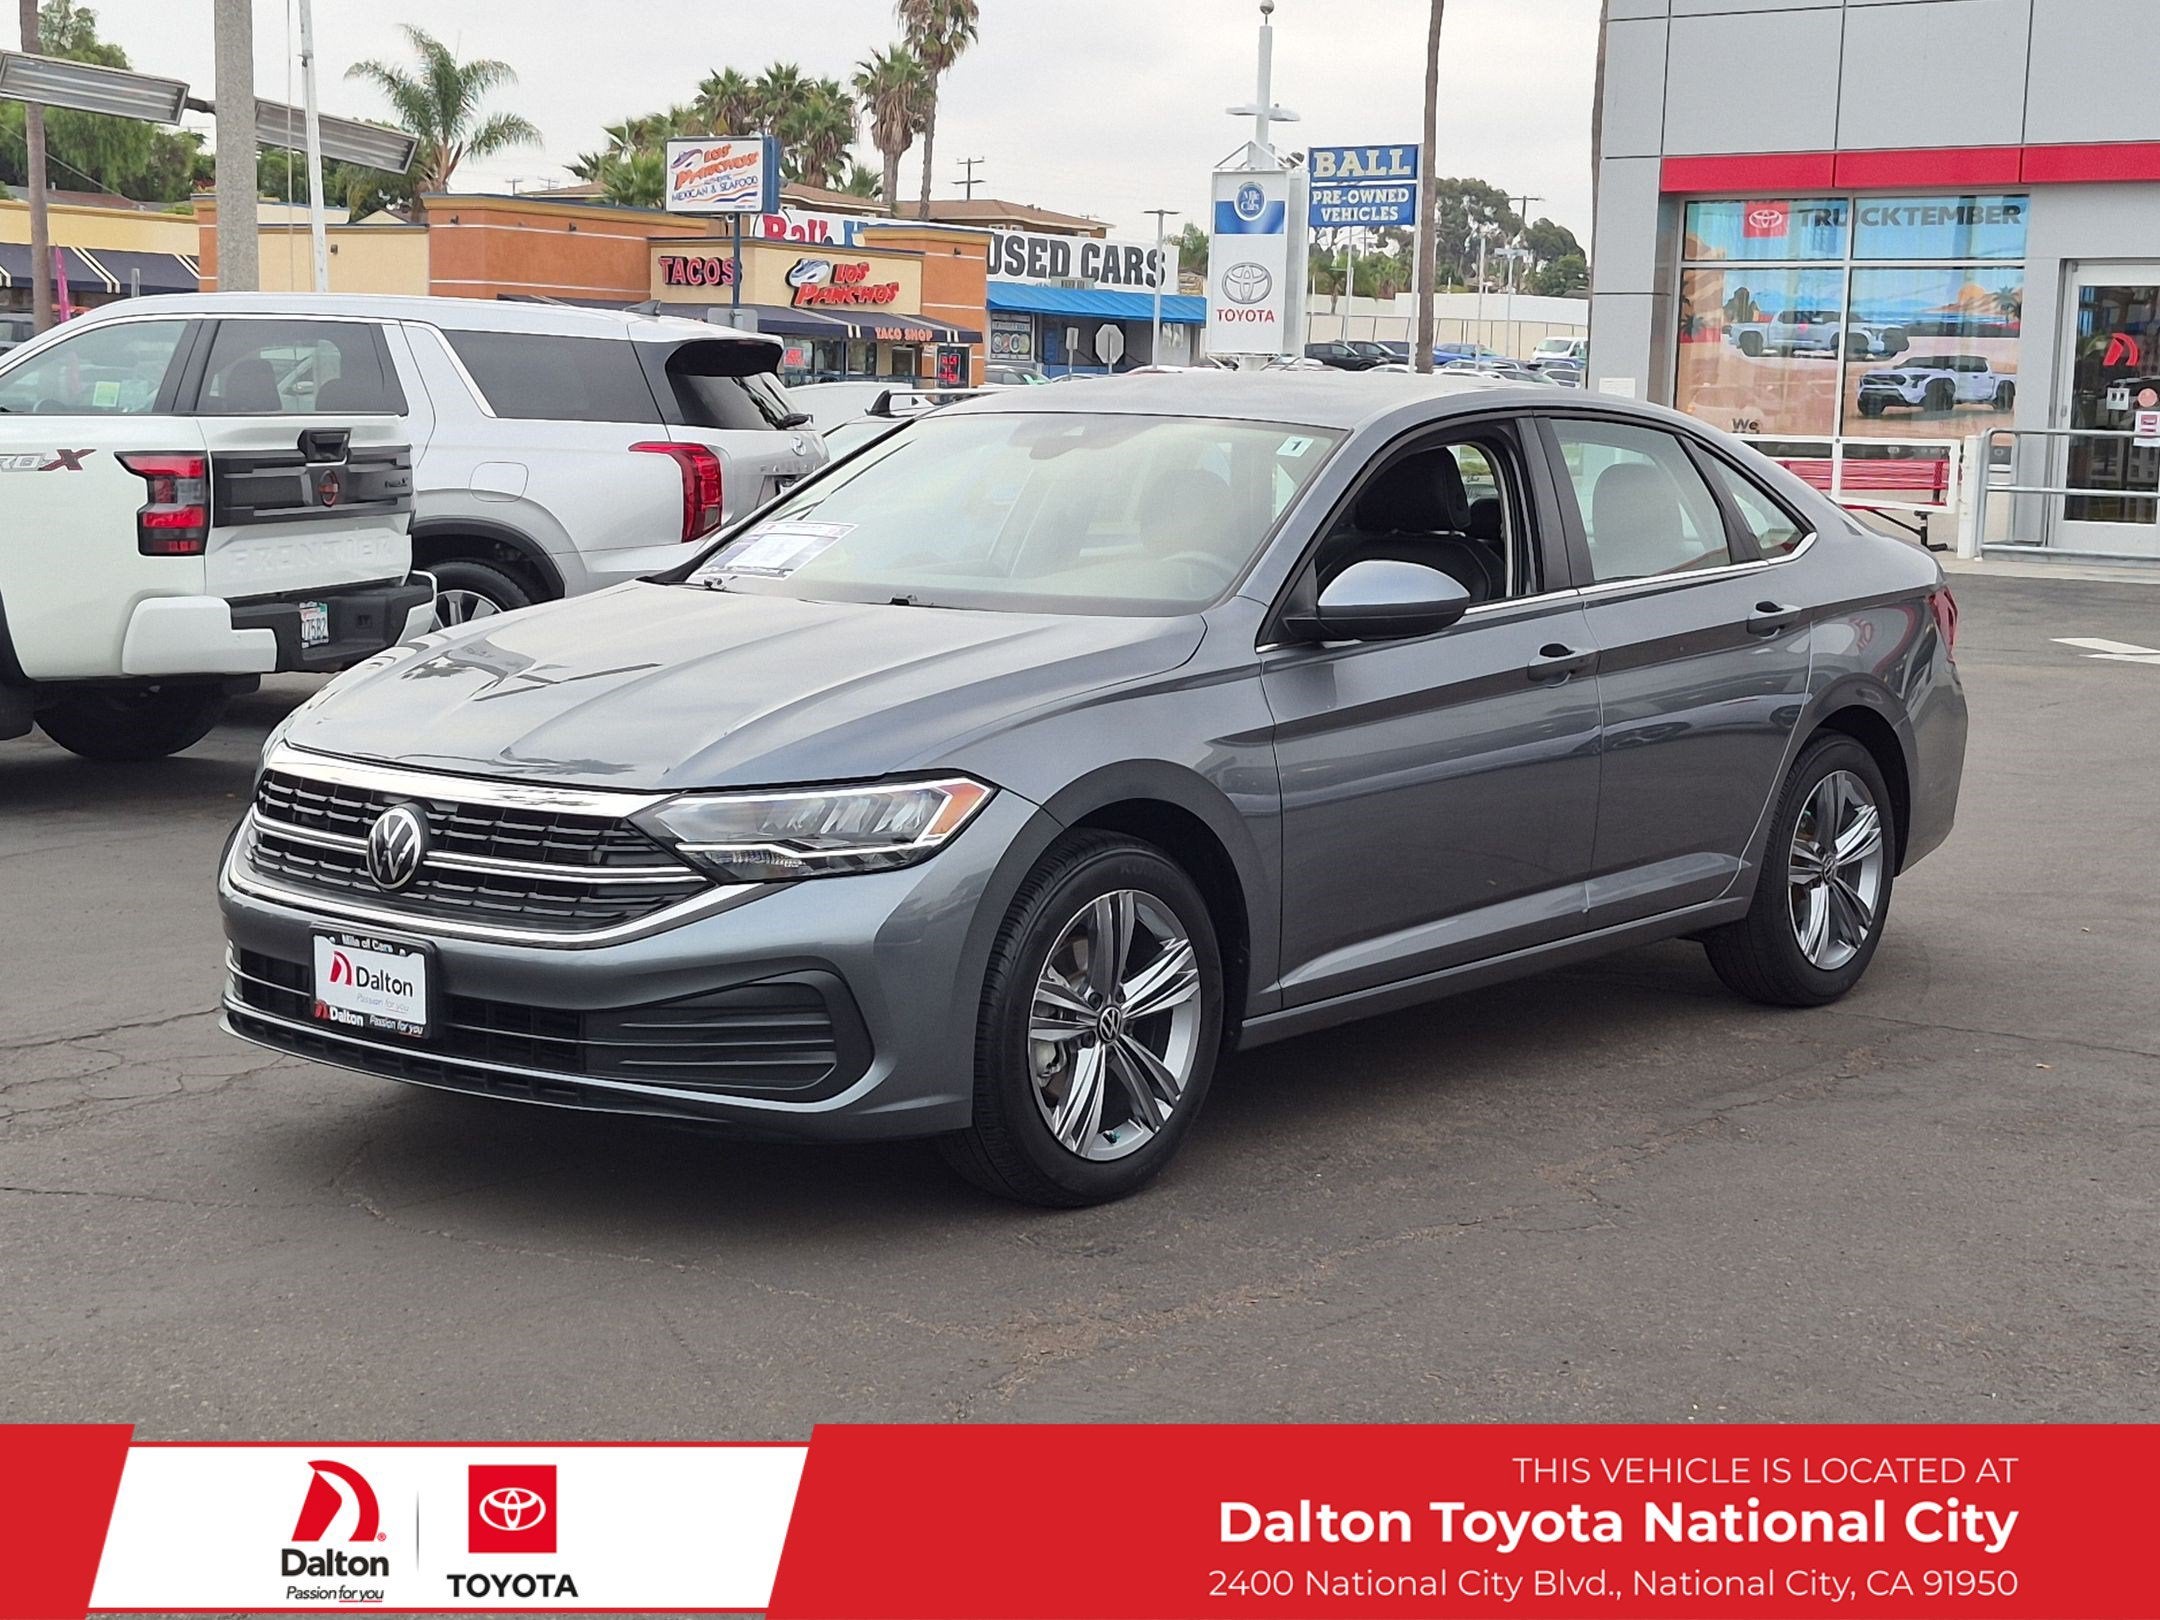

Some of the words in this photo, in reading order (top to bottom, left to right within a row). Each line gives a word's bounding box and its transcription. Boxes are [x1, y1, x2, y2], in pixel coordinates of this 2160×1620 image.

[1313, 149, 1411, 178] BALL
[672, 187, 708, 201] MEXICAN
[720, 175, 758, 191] SEAFOOD
[1312, 188, 1409, 204] PRE-OWNED
[1321, 206, 1399, 221] VEHICLES
[1800, 205, 2022, 227] TRUCKTEMBER
[763, 214, 828, 244] Ball
[658, 256, 741, 285] TACOS
[988, 234, 1071, 278] USED
[1081, 242, 1166, 288] CARS
[1217, 309, 1275, 322] TOYOTA
[875, 326, 902, 340] TACO
[904, 328, 933, 341] SHOP
[1732, 418, 1759, 430] We
[356, 966, 413, 997] Dalton
[329, 1006, 364, 1027] Dalton
[369, 1014, 396, 1030] Passion
[397, 1019, 407, 1031] for
[407, 1024, 424, 1035] you
